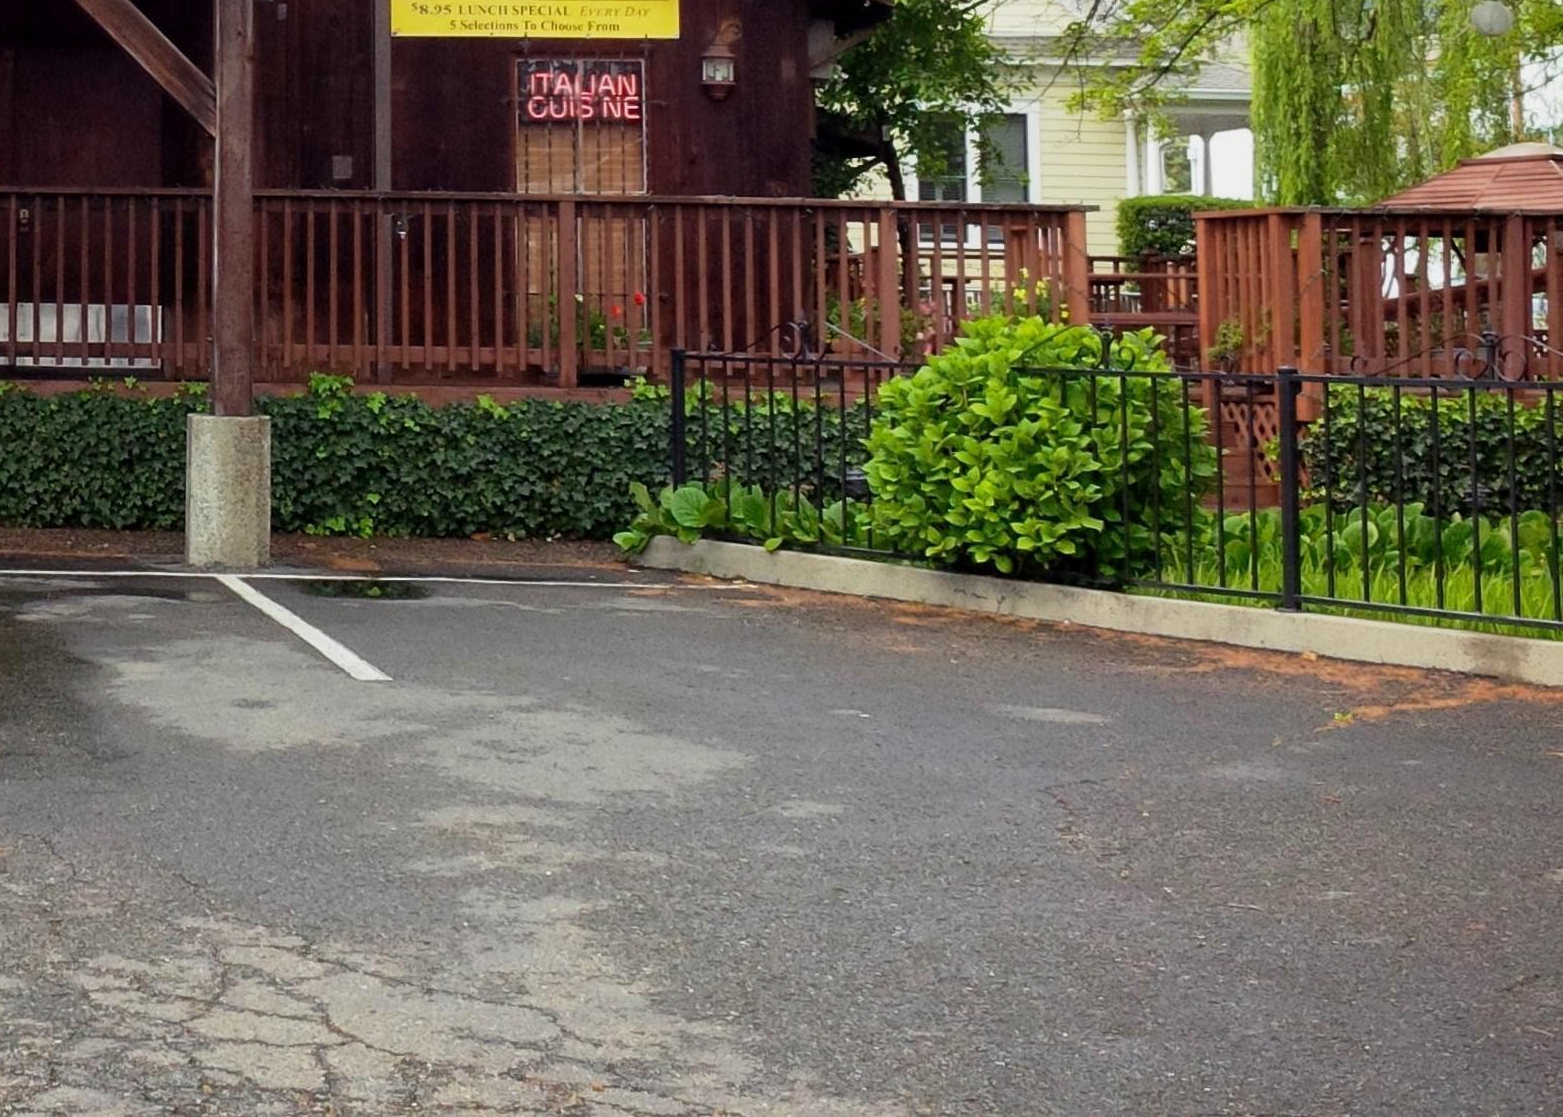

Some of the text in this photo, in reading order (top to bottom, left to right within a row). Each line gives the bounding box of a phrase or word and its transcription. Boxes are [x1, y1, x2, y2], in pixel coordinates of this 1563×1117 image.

[458, 4, 509, 16] LUNCH
[512, 5, 572, 17] SPECIAL
[625, 6, 651, 17] DAY
[449, 20, 621, 32] 5 Selections To Choose From
[529, 72, 637, 96] ITALIAN
[527, 96, 641, 119] CUISNE
